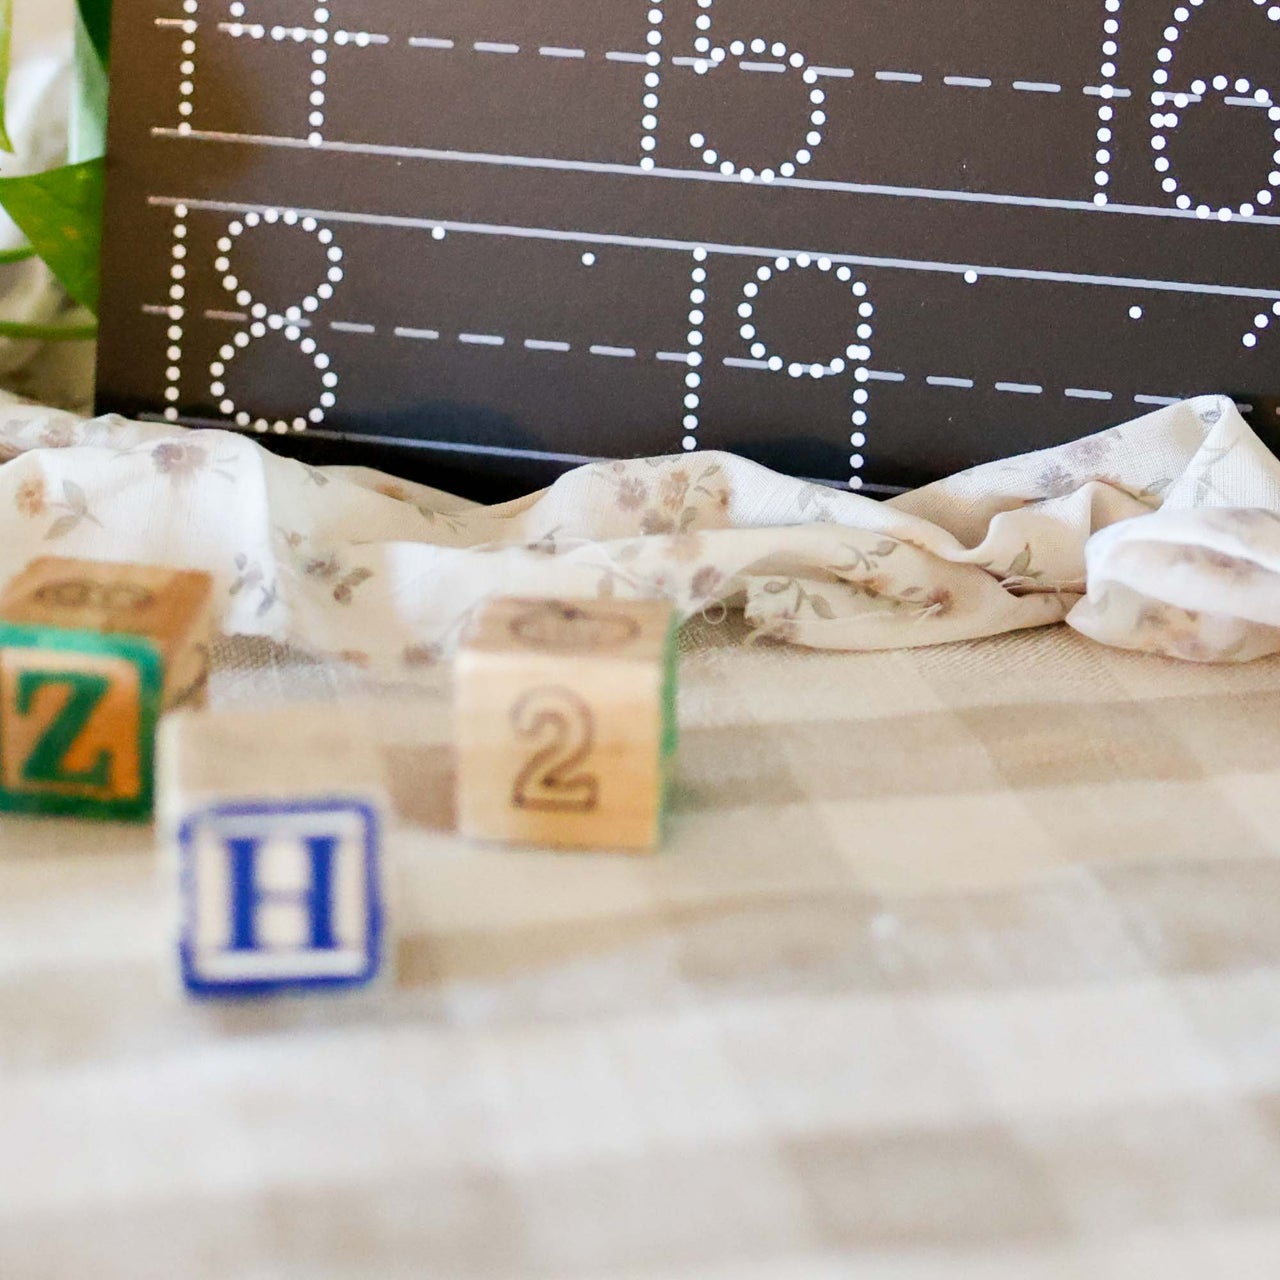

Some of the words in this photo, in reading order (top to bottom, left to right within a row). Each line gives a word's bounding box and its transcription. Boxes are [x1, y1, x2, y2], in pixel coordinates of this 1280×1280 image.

[164, 204, 342, 434] 18
[682, 247, 873, 490] 19
[16, 672, 111, 788] Z
[509, 686, 600, 812] 2
[222, 835, 340, 951] H
